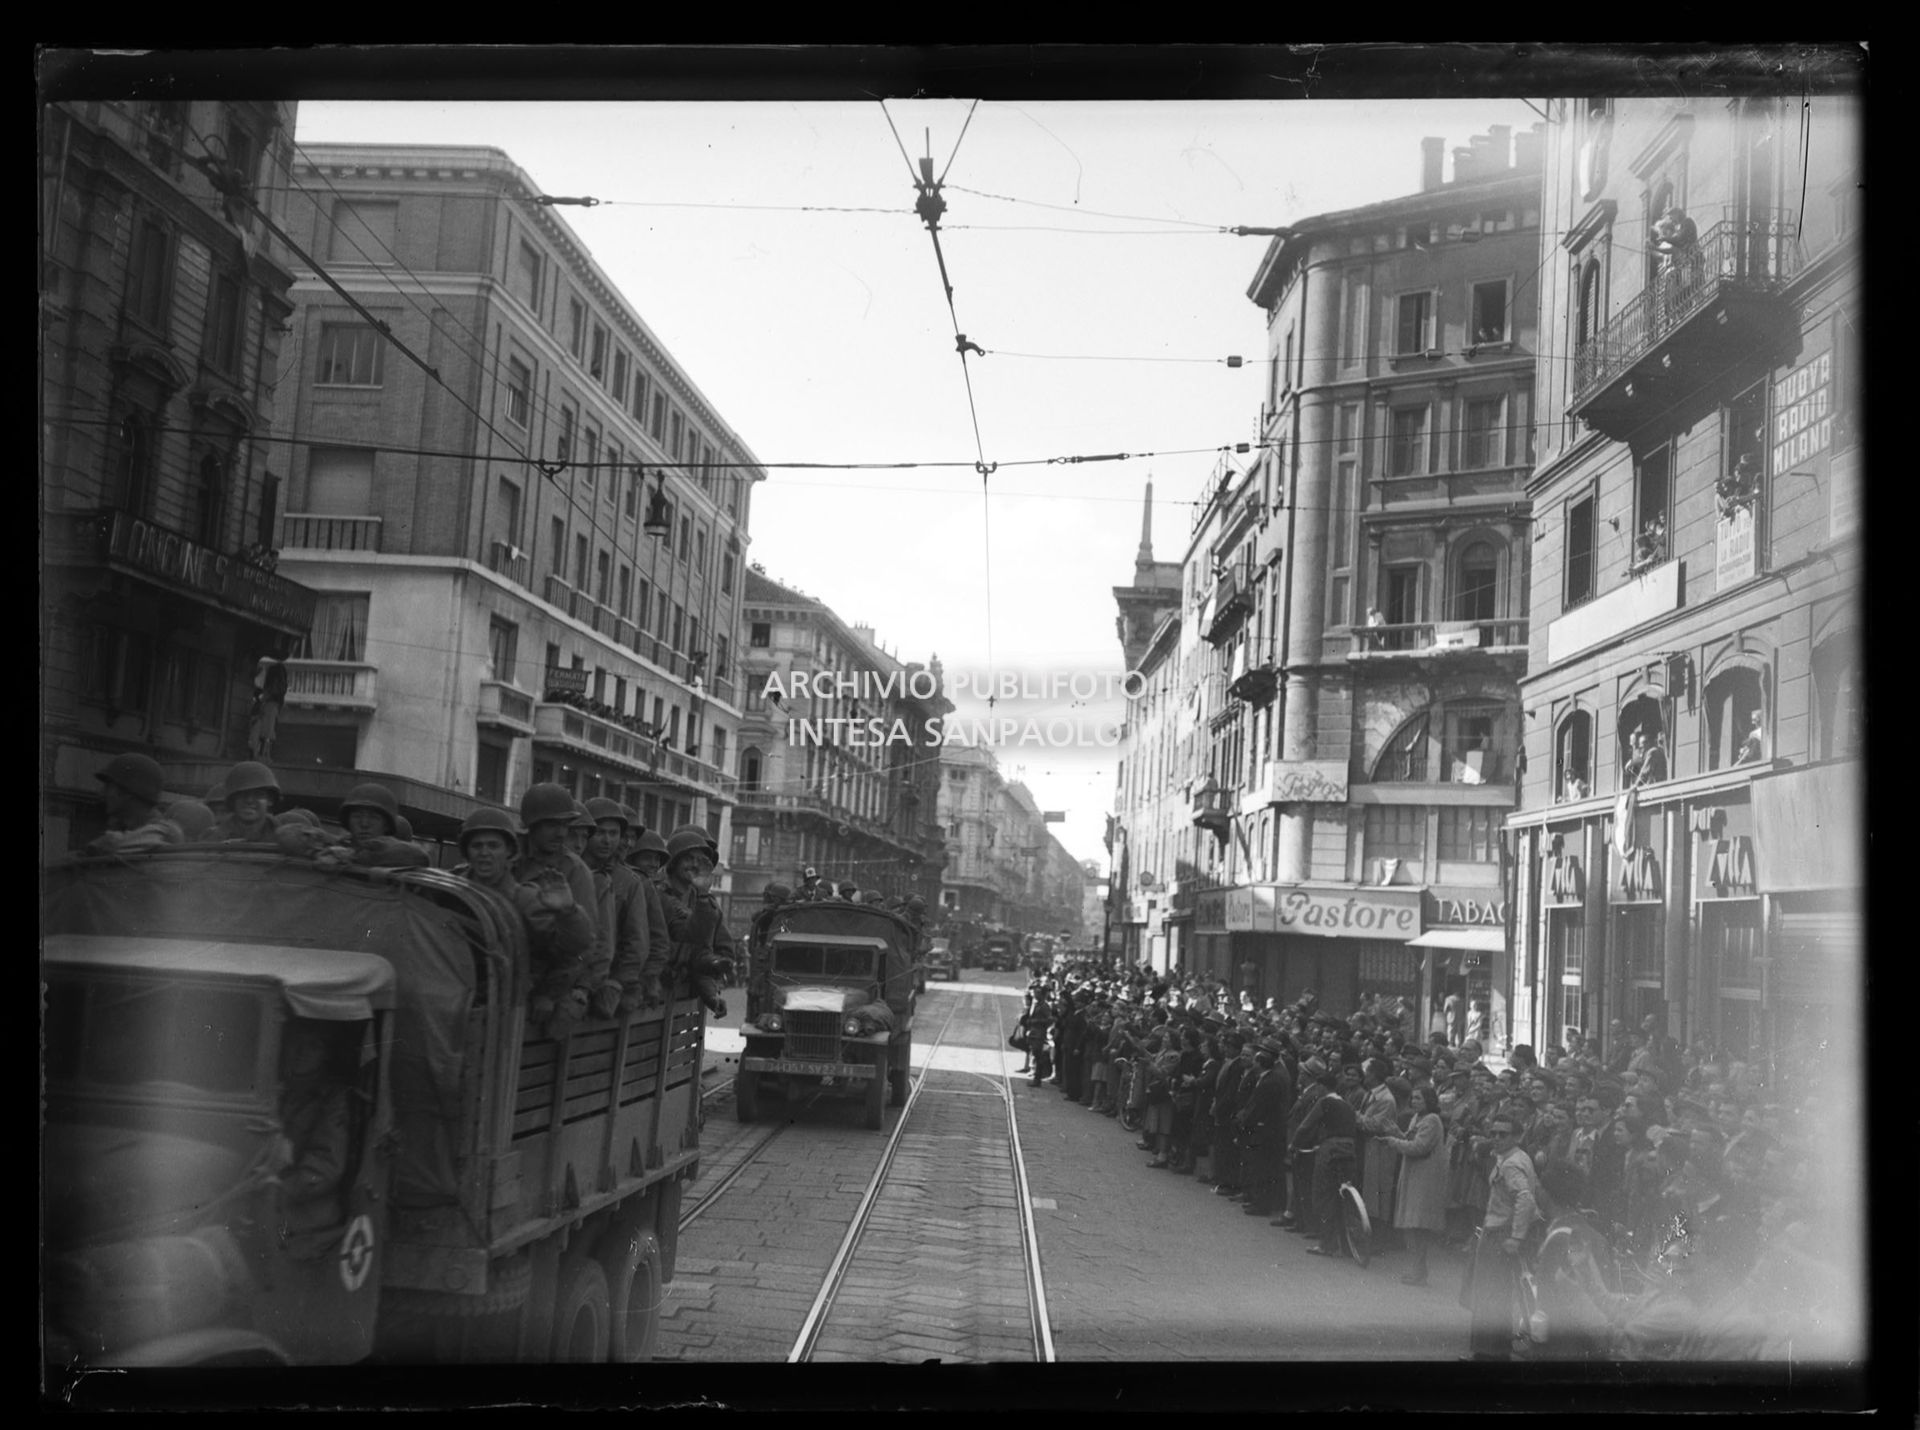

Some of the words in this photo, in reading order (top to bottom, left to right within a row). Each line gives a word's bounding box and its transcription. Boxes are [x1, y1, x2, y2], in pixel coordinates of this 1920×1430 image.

[1776, 354, 1829, 410] NUOVA
[1779, 388, 1827, 441] RADIO
[1774, 418, 1831, 476] MILANO
[109, 512, 229, 595] LONGINES
[1278, 891, 1414, 931] Pastore
